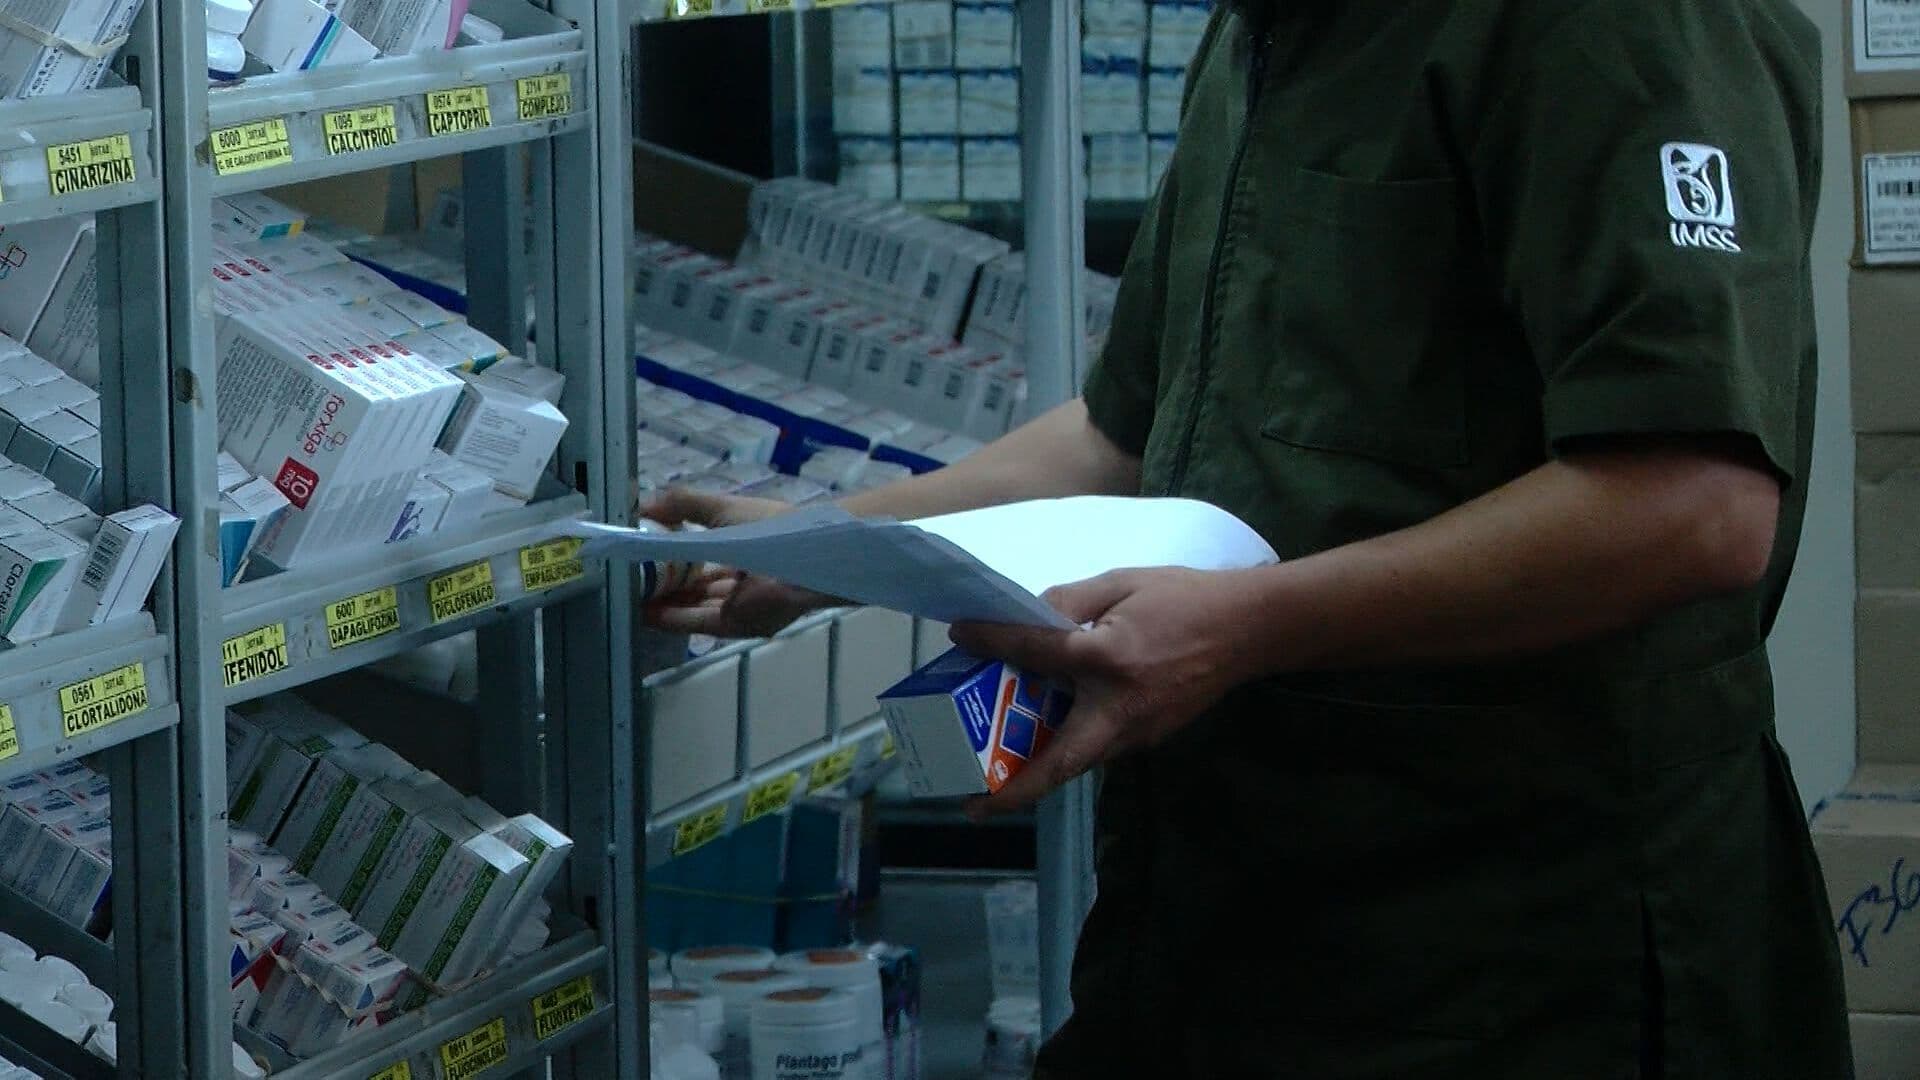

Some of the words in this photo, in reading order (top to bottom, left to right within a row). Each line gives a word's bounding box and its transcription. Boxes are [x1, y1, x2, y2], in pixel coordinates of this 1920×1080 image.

[433, 108, 490, 132] CAPTOPRIL
[522, 96, 564, 118] COMPLEJO
[219, 129, 241, 148] 6000
[331, 127, 396, 154] CALCITRIOL
[58, 144, 82, 166] 5451
[56, 158, 133, 194] CINARIZINA
[1668, 222, 1742, 252] IMSS
[303, 393, 346, 455] forxiga
[290, 473, 313, 498] 10
[335, 601, 355, 620] 6007
[435, 585, 493, 618] DICLOFENACO
[331, 608, 397, 643] DAPAGLIFOZINA
[223, 645, 284, 685] IFENIDOL
[67, 689, 147, 732] CLORTALIDONA
